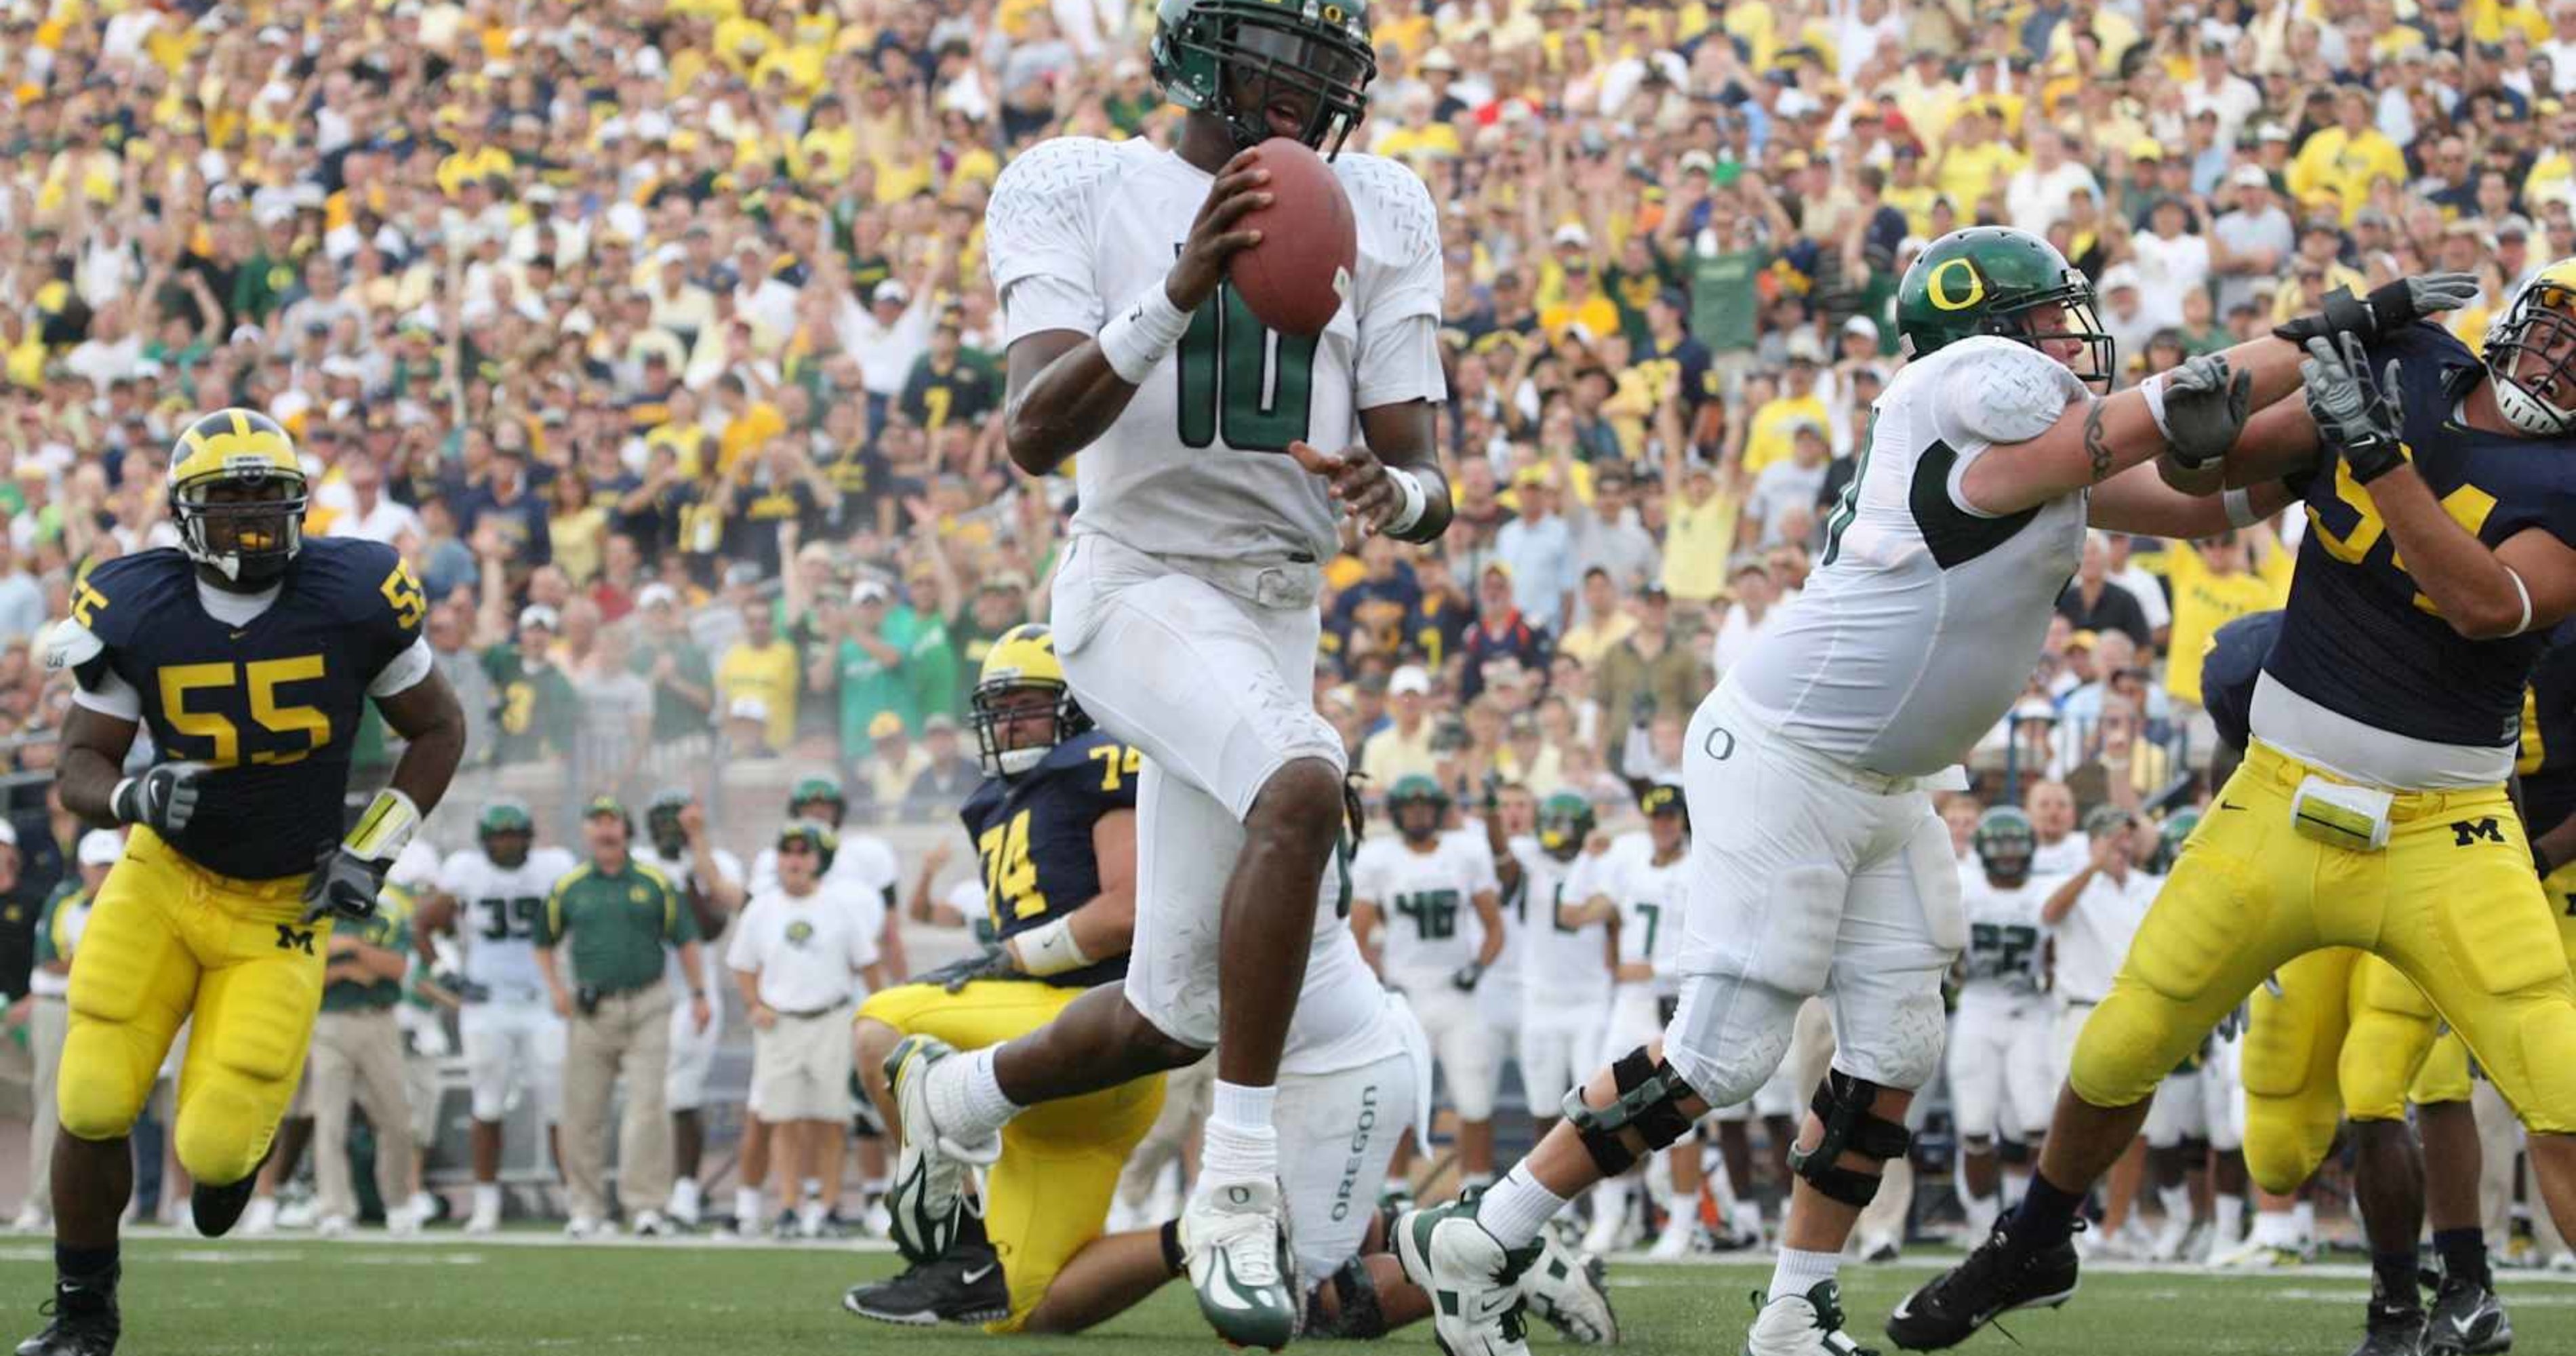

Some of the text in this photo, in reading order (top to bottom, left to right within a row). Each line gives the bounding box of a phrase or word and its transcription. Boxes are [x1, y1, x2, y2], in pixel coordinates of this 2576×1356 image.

[1927, 257, 1985, 310] O
[1177, 275, 1322, 452] 10
[157, 654, 331, 769] 55
[1705, 727, 1735, 761] O
[2451, 818, 2506, 847] M
[978, 808, 1047, 932] 74
[275, 923, 315, 956] M
[479, 897, 542, 940] 39
[1635, 902, 1660, 957] 7
[1331, 1085, 1377, 1222] OREGON
[1228, 1186, 1250, 1205] O
